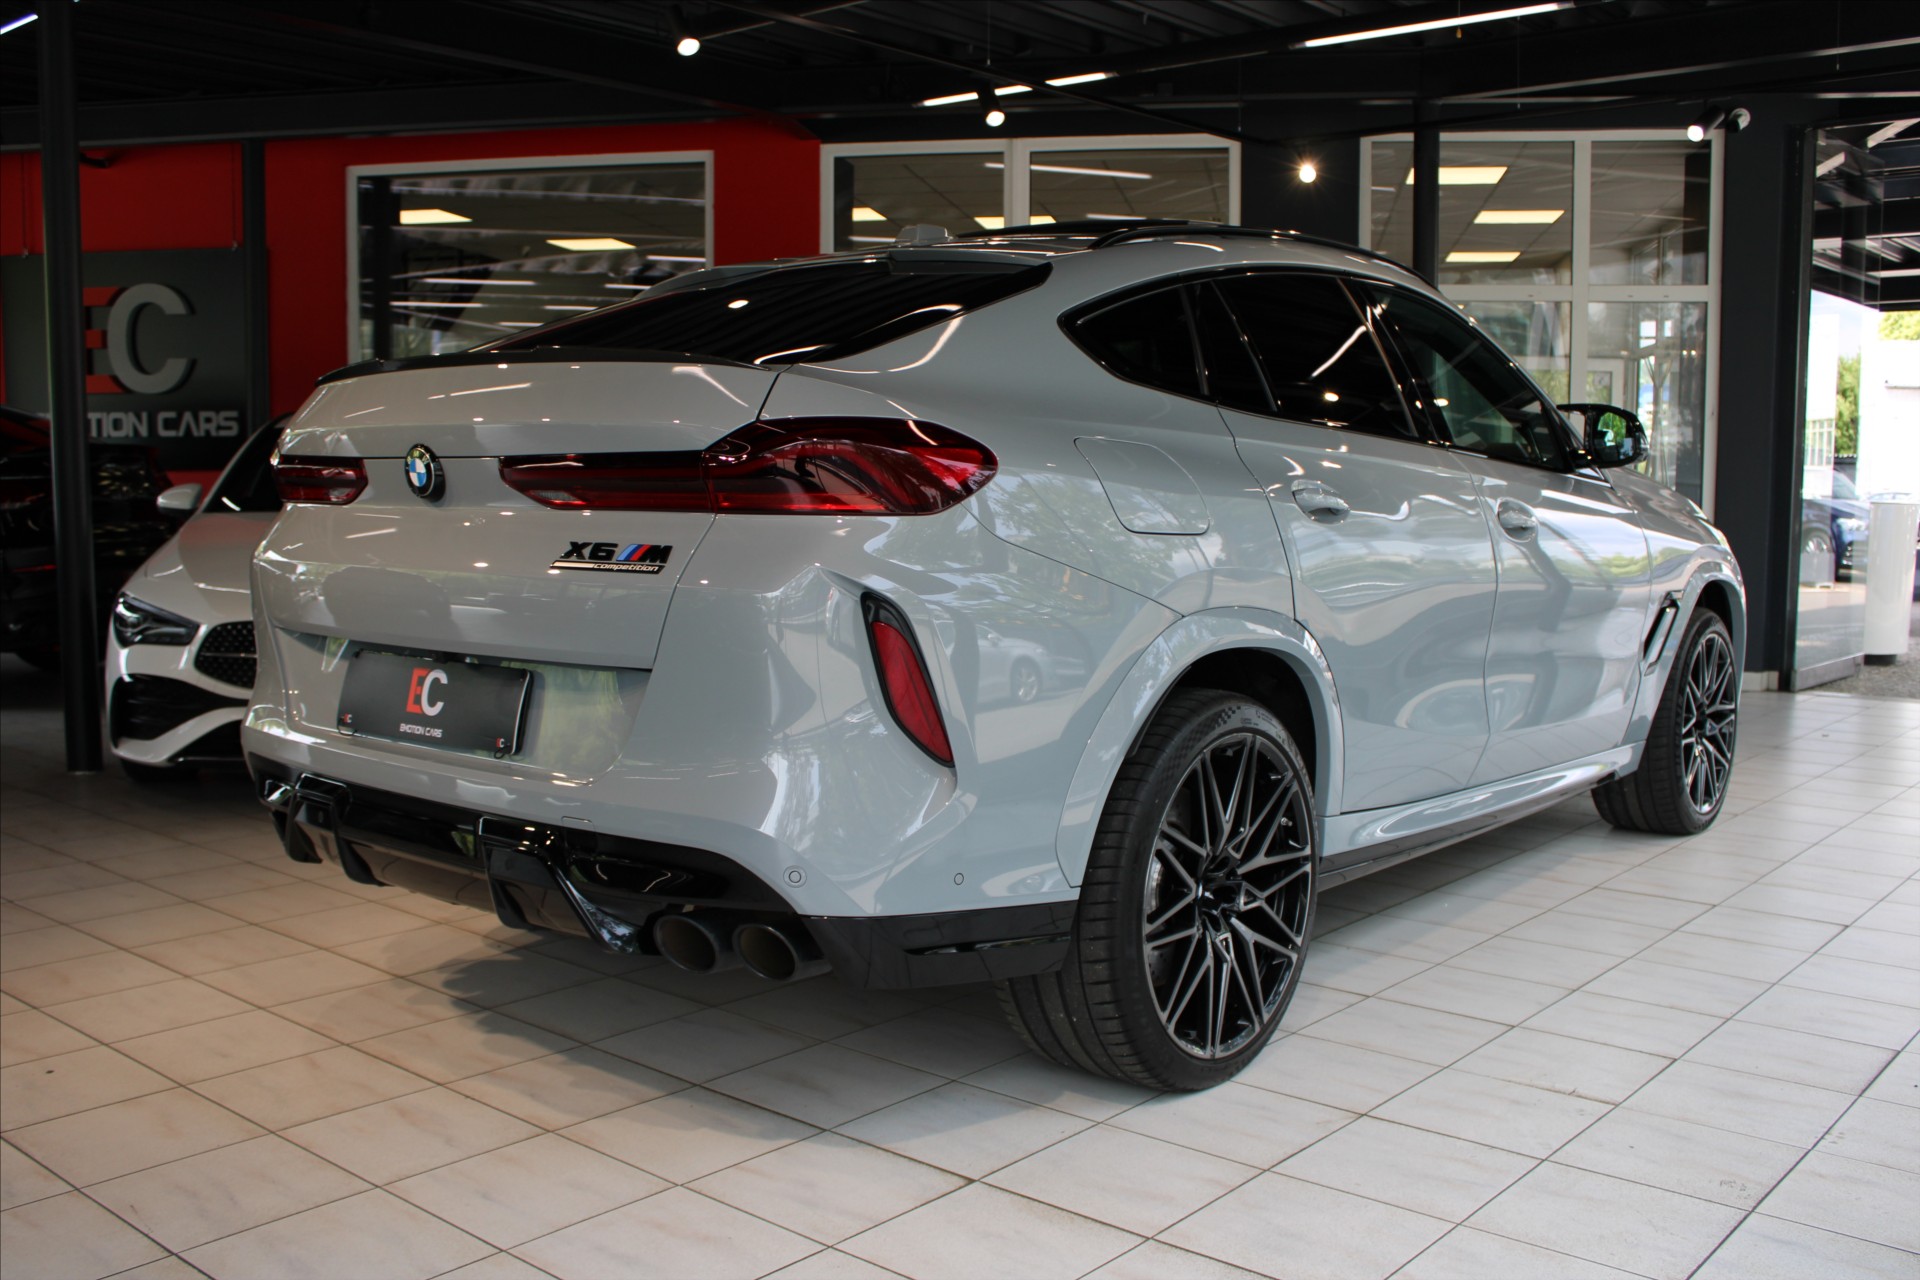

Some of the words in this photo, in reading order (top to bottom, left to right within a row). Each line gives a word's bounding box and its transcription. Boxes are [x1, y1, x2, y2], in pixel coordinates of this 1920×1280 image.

[87, 411, 148, 437] TION
[157, 411, 239, 437] CARS
[593, 563, 659, 572] competition
[406, 668, 448, 716] EC
